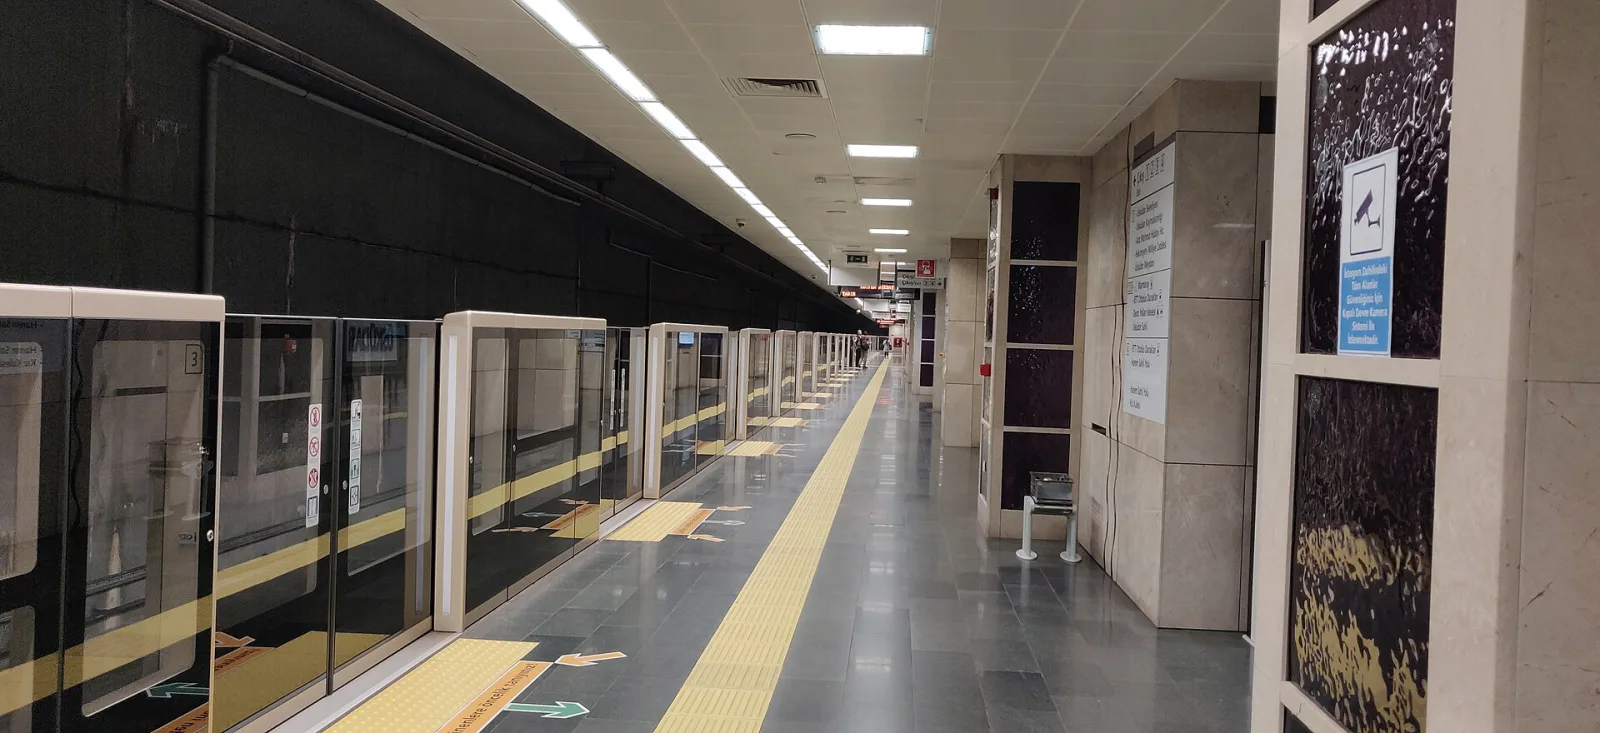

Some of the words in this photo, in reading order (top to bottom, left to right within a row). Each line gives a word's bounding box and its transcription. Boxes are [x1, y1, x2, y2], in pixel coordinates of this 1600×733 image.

[1351, 280, 1361, 290] Tüm
[1370, 307, 1388, 317] Kamera
[191, 351, 198, 367] 3
